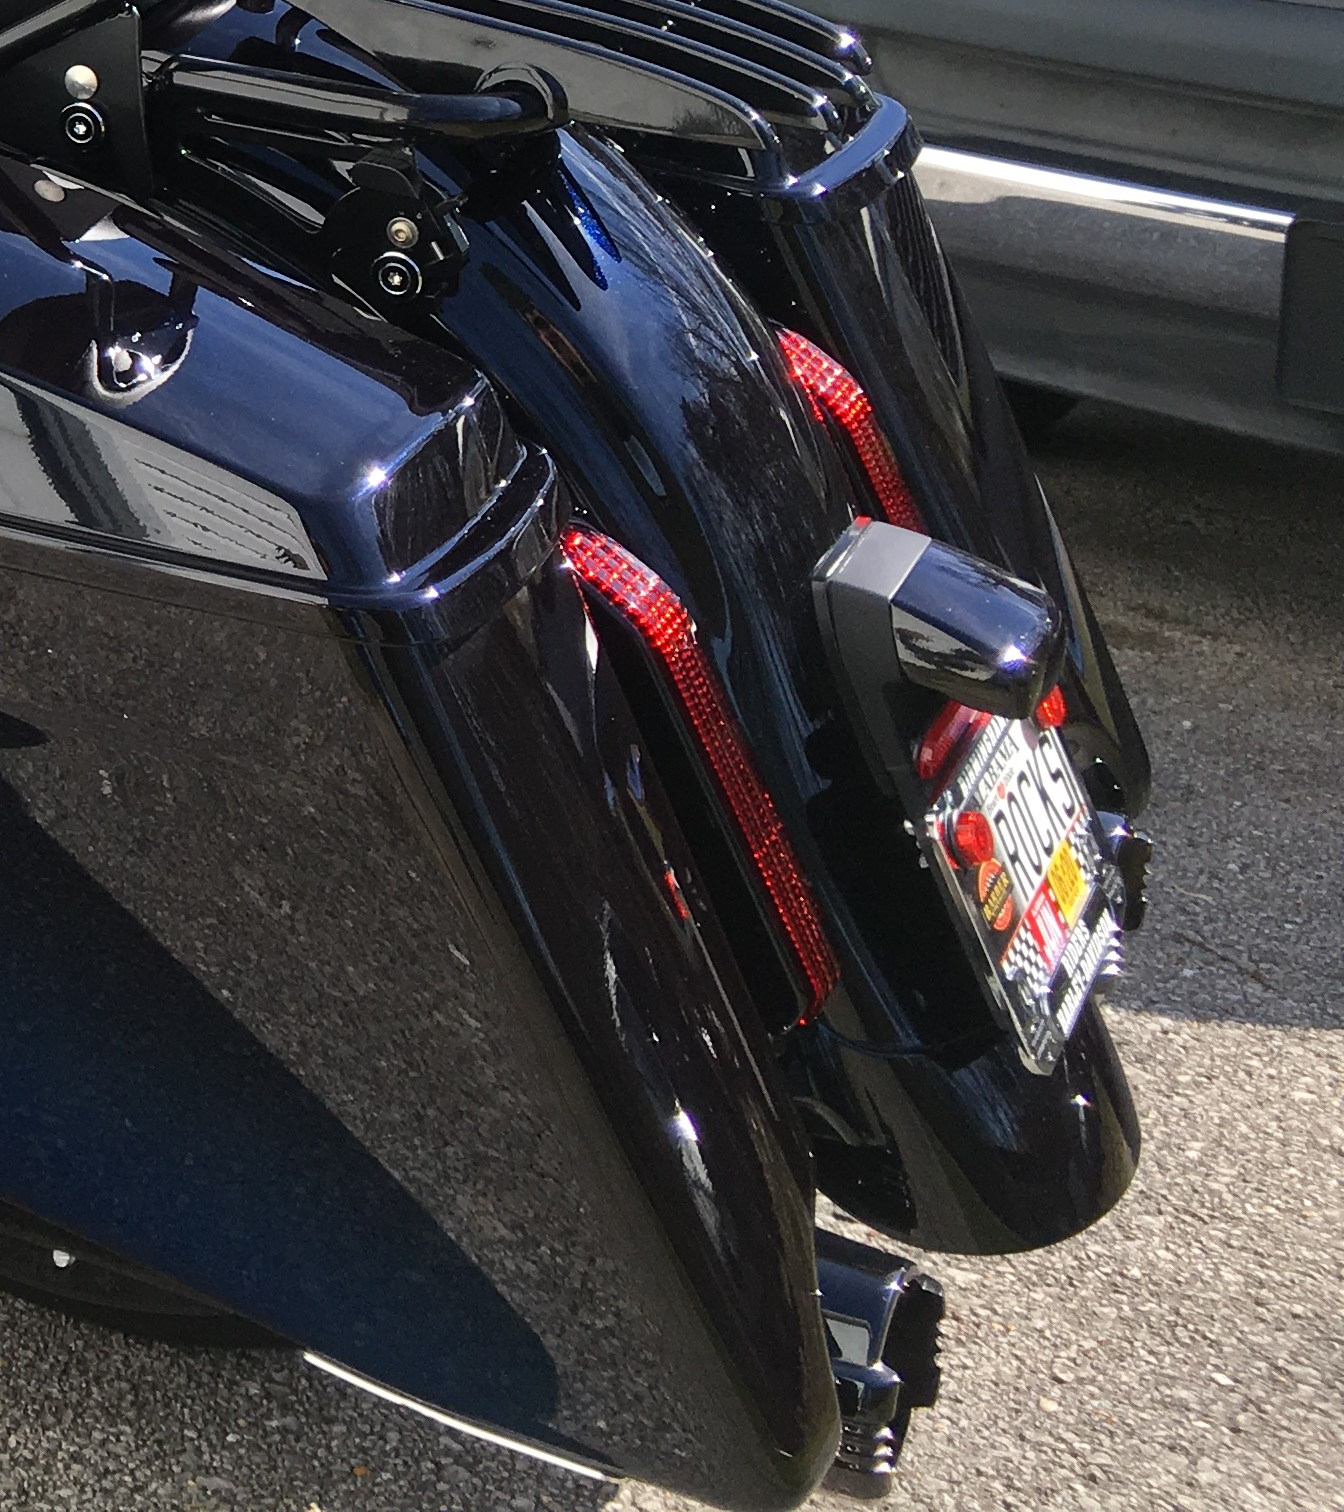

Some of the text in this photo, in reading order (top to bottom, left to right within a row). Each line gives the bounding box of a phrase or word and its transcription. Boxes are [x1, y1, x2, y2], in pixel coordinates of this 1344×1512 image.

[993, 730, 1076, 903] ROCKS
[1056, 908, 1112, 1039] HARLEY-DAVIDSON
[1061, 918, 1091, 978] RIDERS
